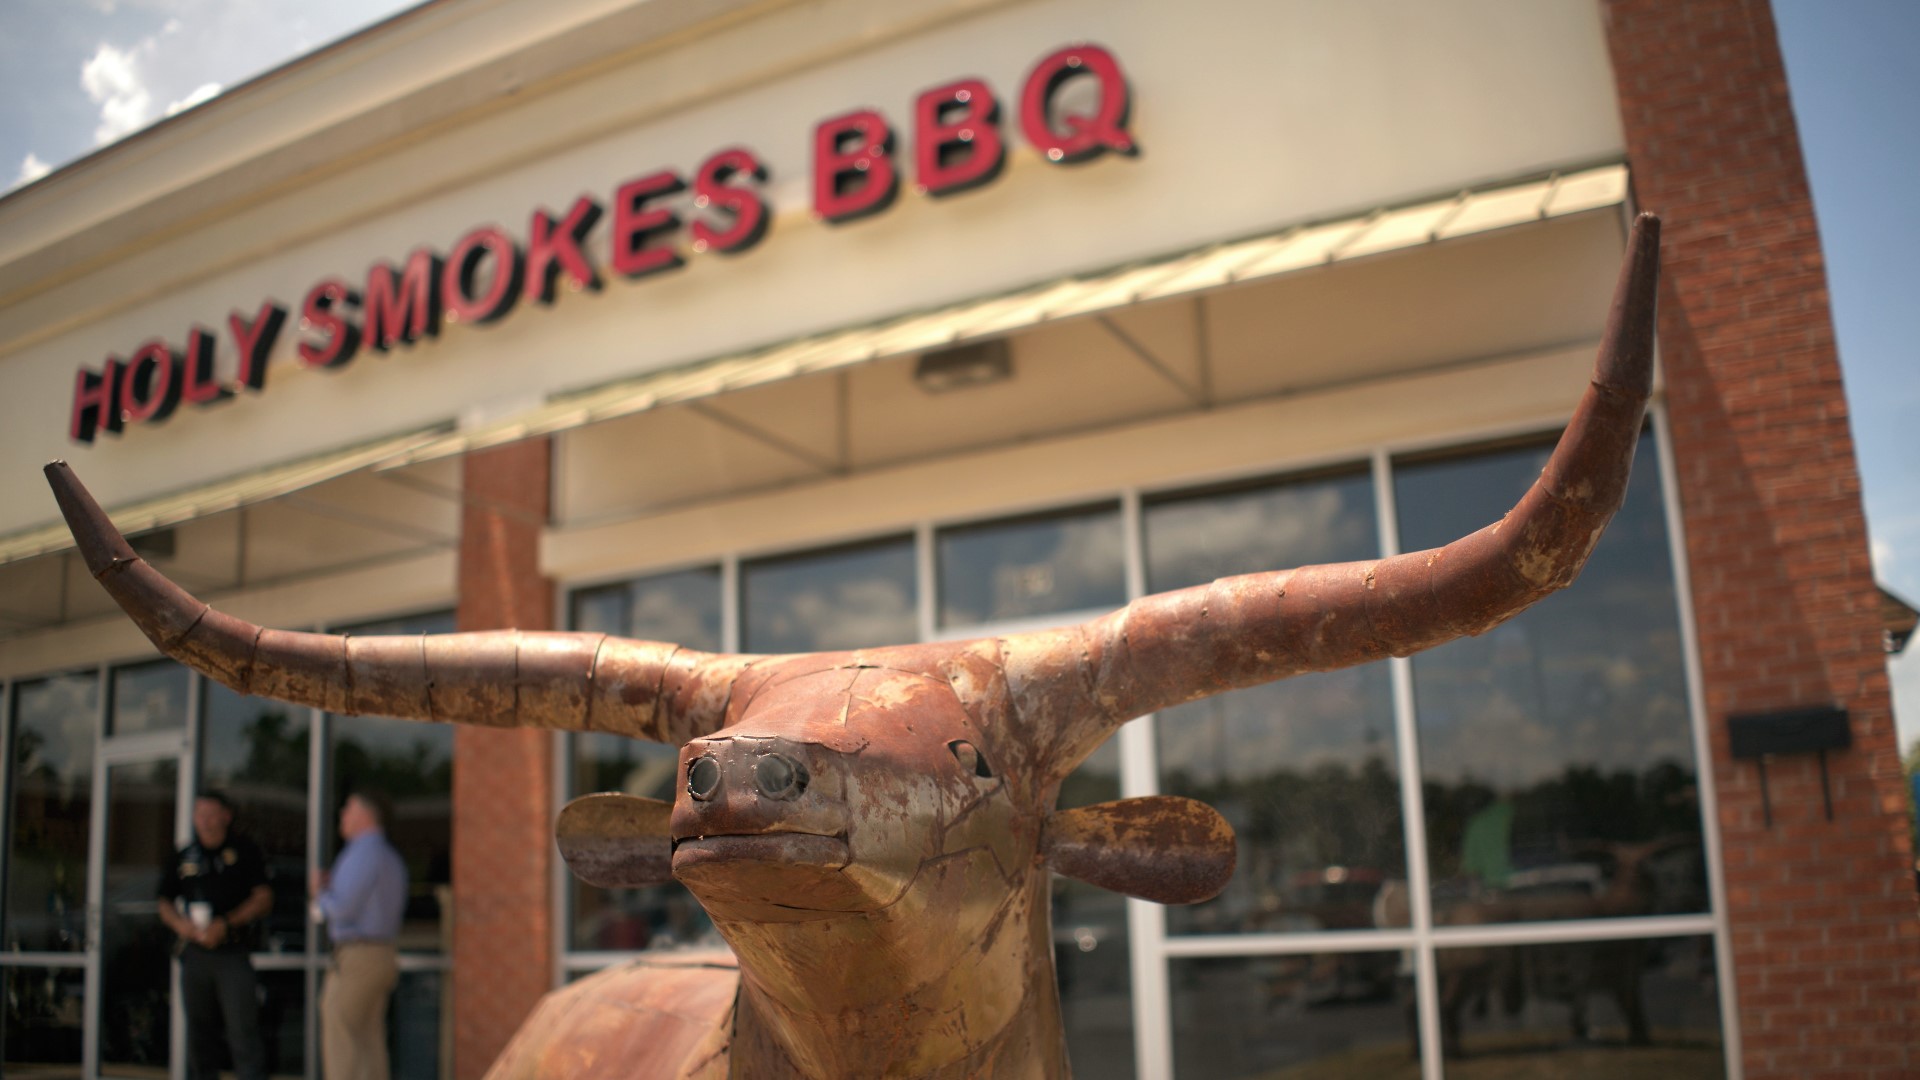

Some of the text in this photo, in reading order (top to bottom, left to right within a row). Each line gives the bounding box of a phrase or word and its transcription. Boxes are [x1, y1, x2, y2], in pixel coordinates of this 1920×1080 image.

[69, 43, 1141, 445] HOLY SMOKES BBQ
